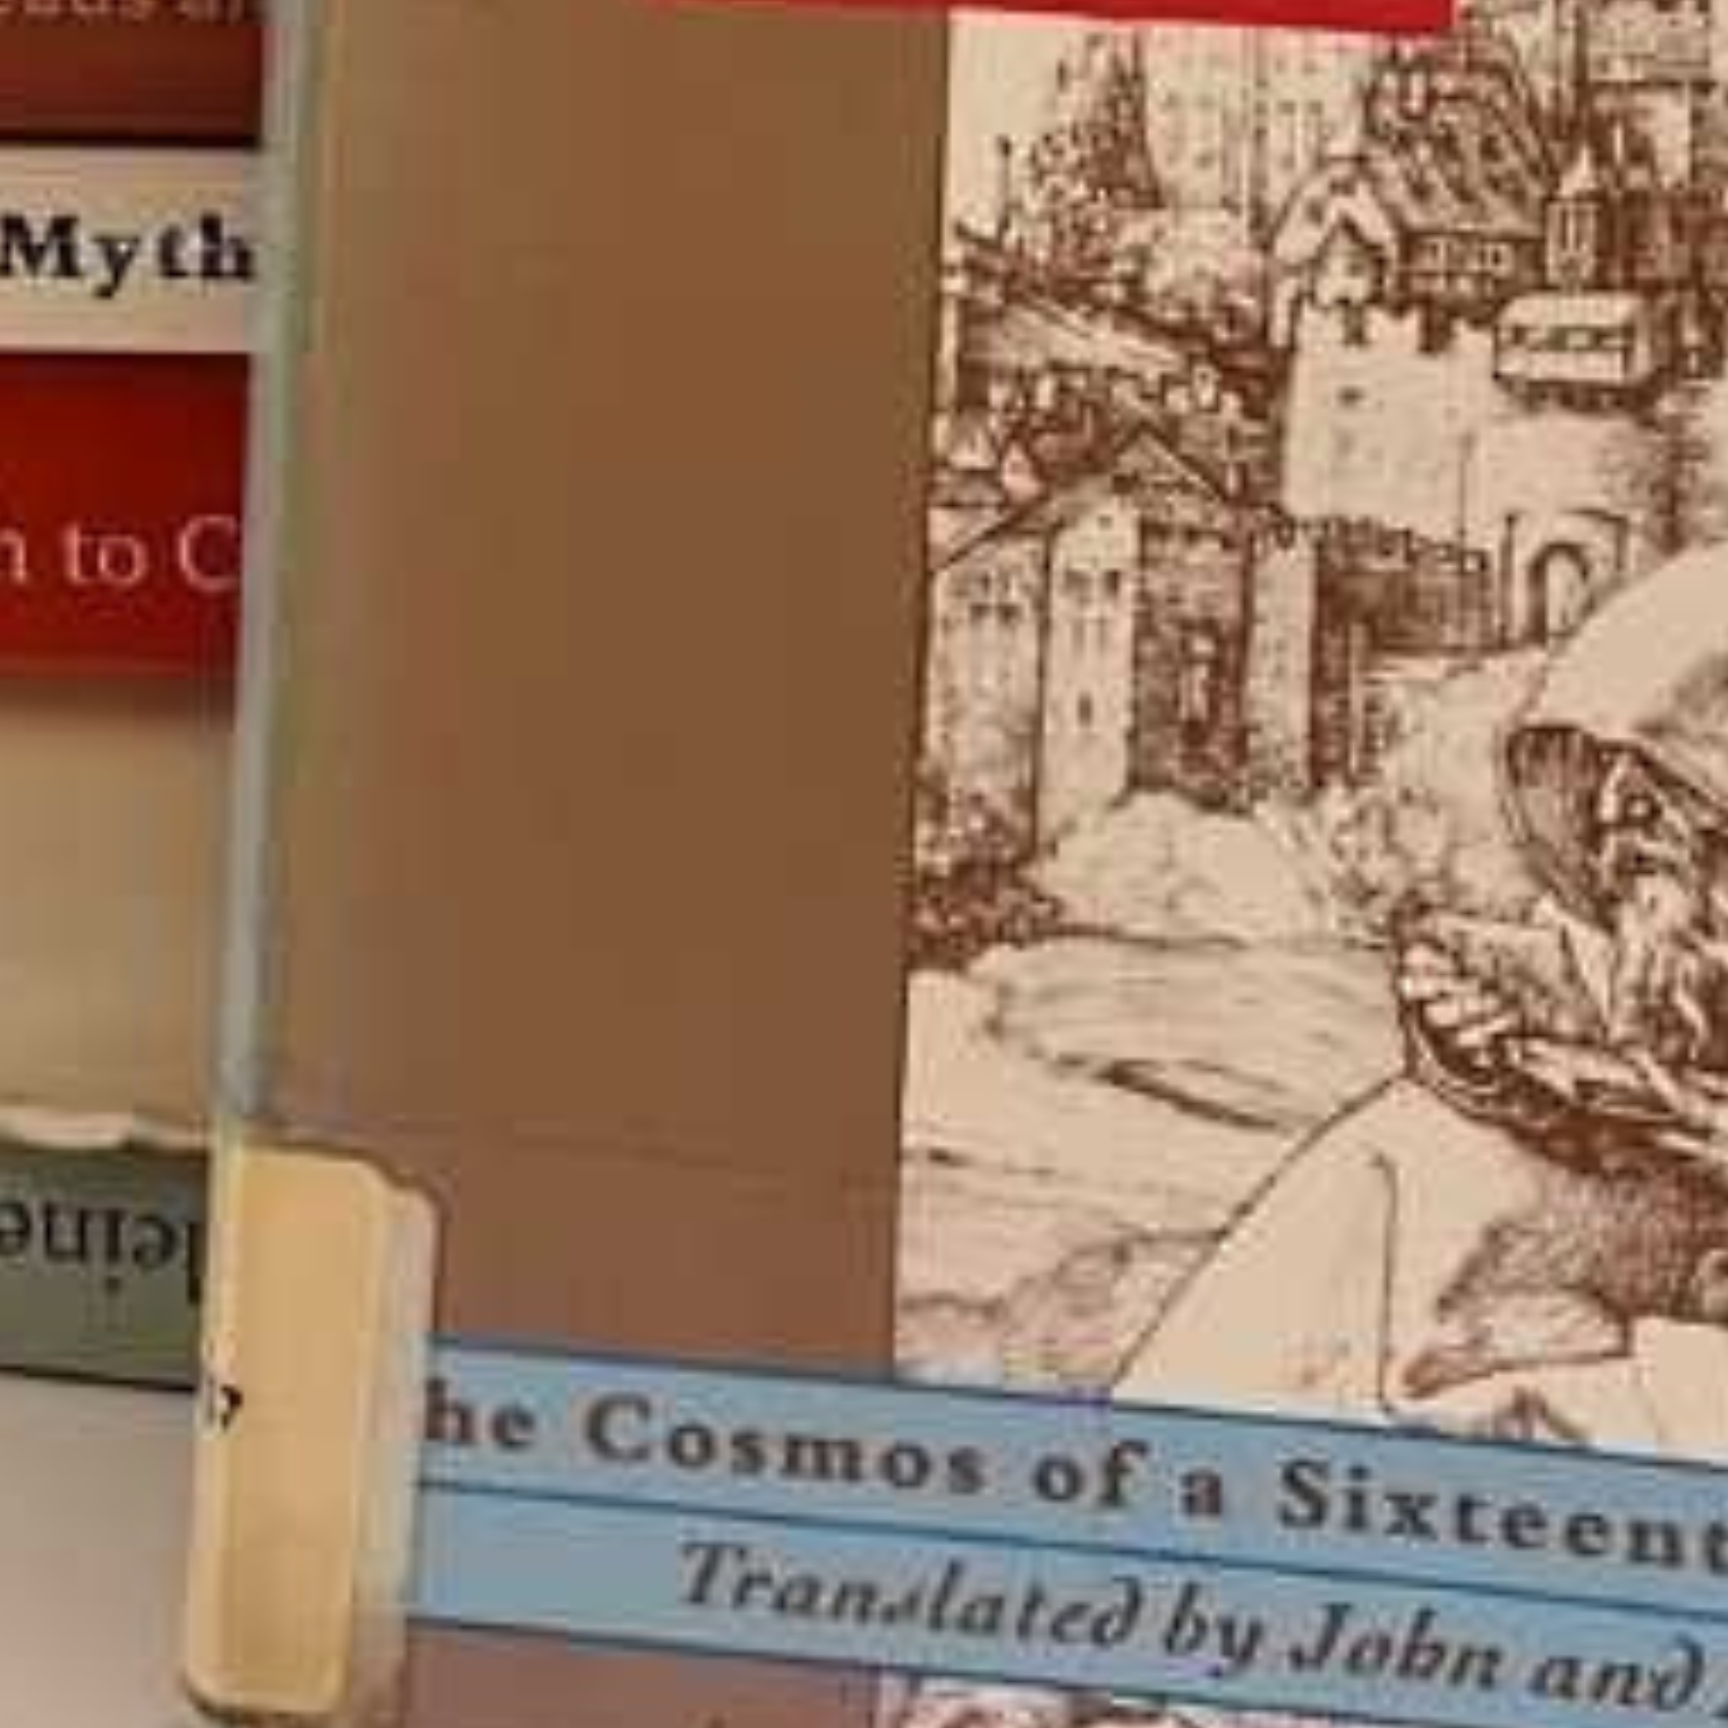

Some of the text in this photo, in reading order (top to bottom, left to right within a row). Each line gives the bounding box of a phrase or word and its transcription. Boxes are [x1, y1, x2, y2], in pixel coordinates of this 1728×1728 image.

[62, 519, 148, 588] to
[424, 1378, 536, 1452] he
[583, 1389, 984, 1495] Cosmos
[1029, 1439, 1148, 1508] of
[1176, 1462, 1227, 1520] a
[676, 1538, 1145, 1651] Translated
[1160, 1580, 1264, 1679] by
[1286, 1601, 1504, 1688] John
[1528, 1633, 1707, 1712] and
